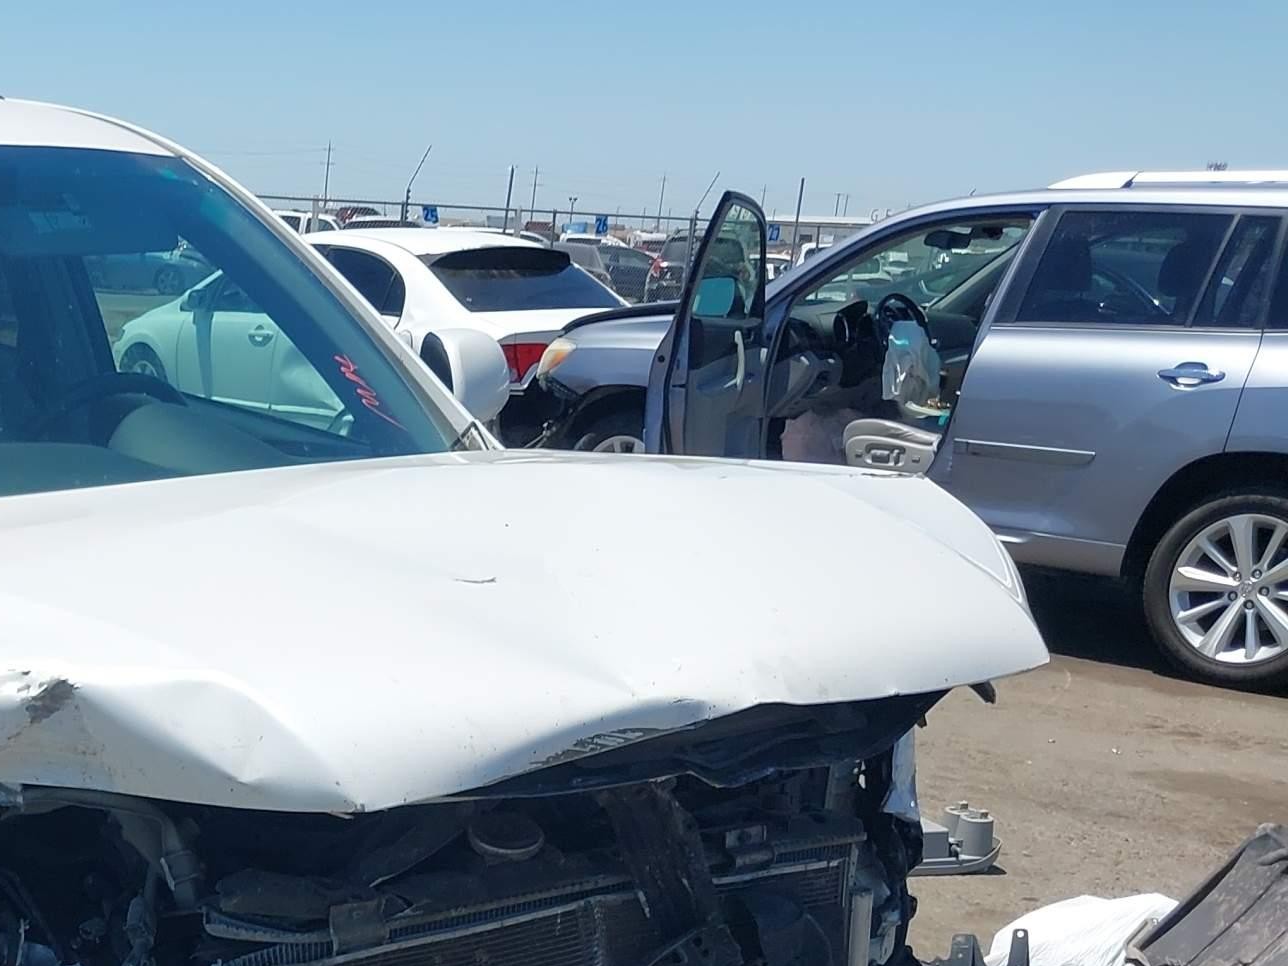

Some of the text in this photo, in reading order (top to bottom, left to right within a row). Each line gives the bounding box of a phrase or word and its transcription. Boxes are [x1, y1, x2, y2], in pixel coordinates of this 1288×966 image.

[422, 206, 439, 224] 25
[595, 216, 609, 234] 26
[768, 224, 780, 241] 27
